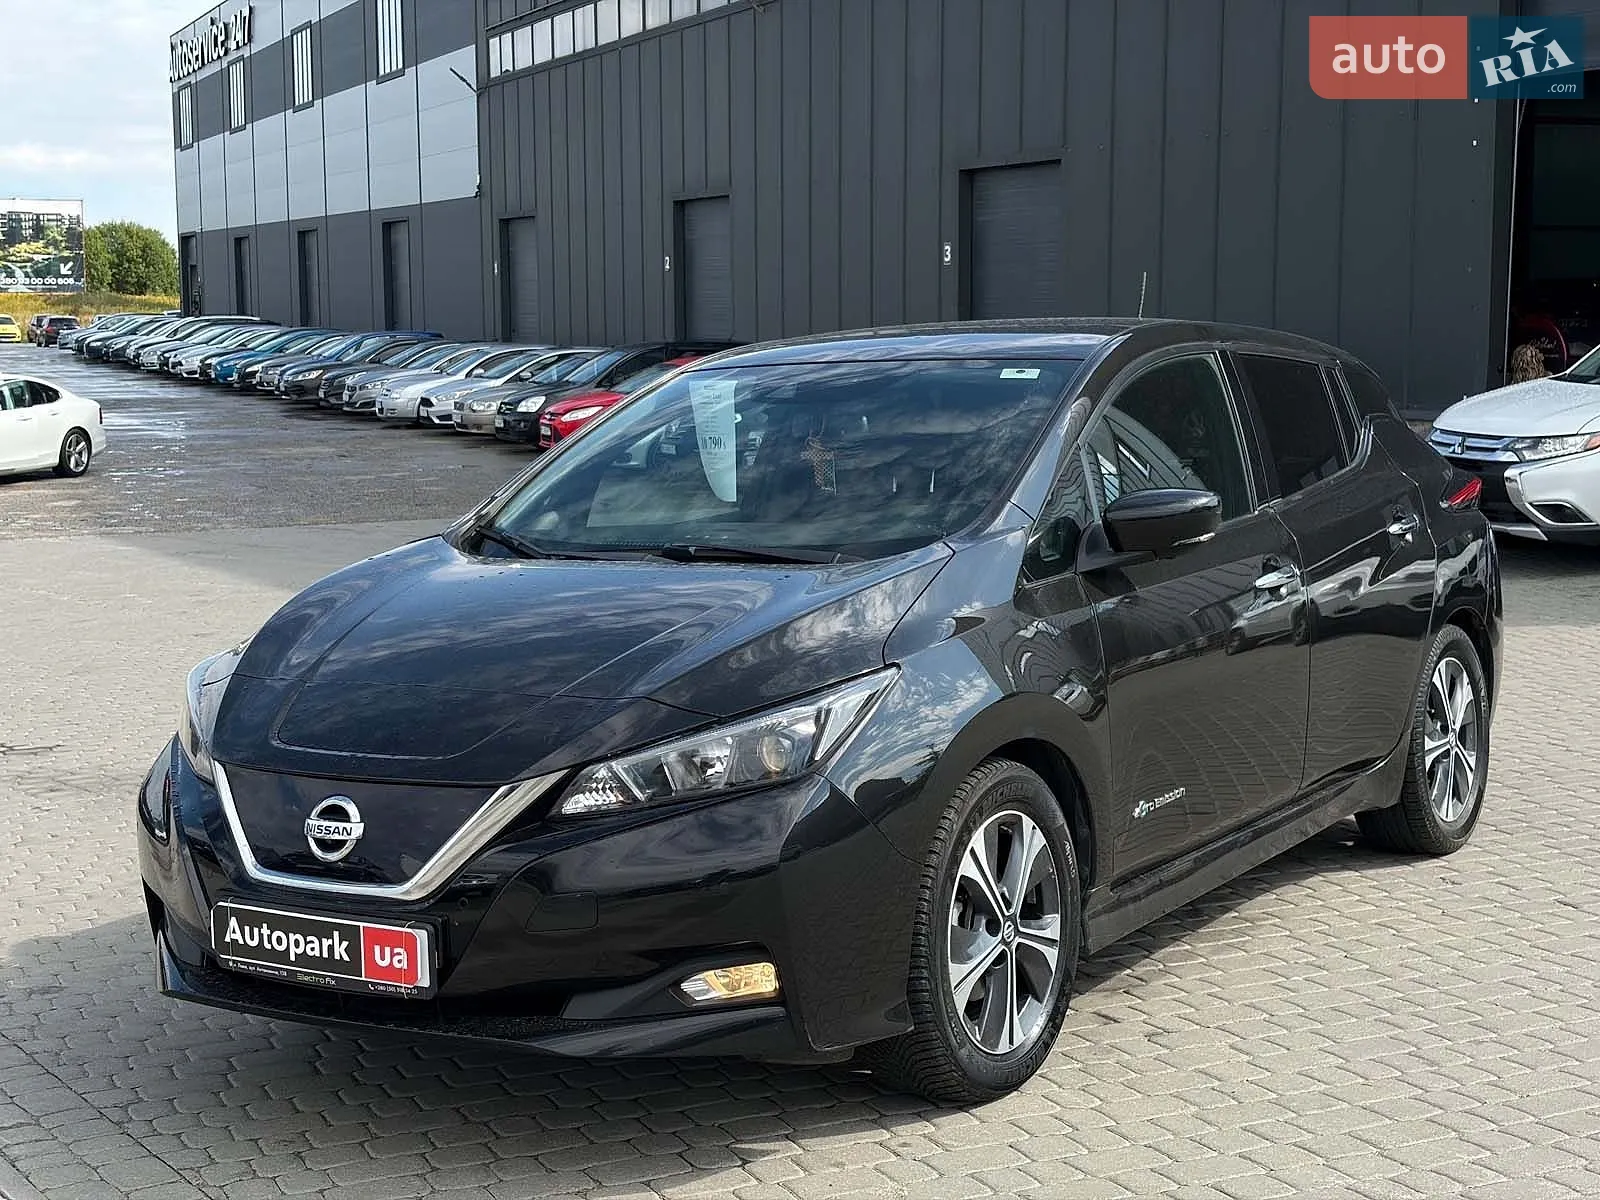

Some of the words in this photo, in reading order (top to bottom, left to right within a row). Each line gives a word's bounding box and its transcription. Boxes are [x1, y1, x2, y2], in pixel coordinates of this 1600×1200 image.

[944, 245, 951, 262] 3
[306, 823, 353, 837] NISSAN
[224, 916, 351, 962] Autopark
[374, 943, 409, 970] ua
